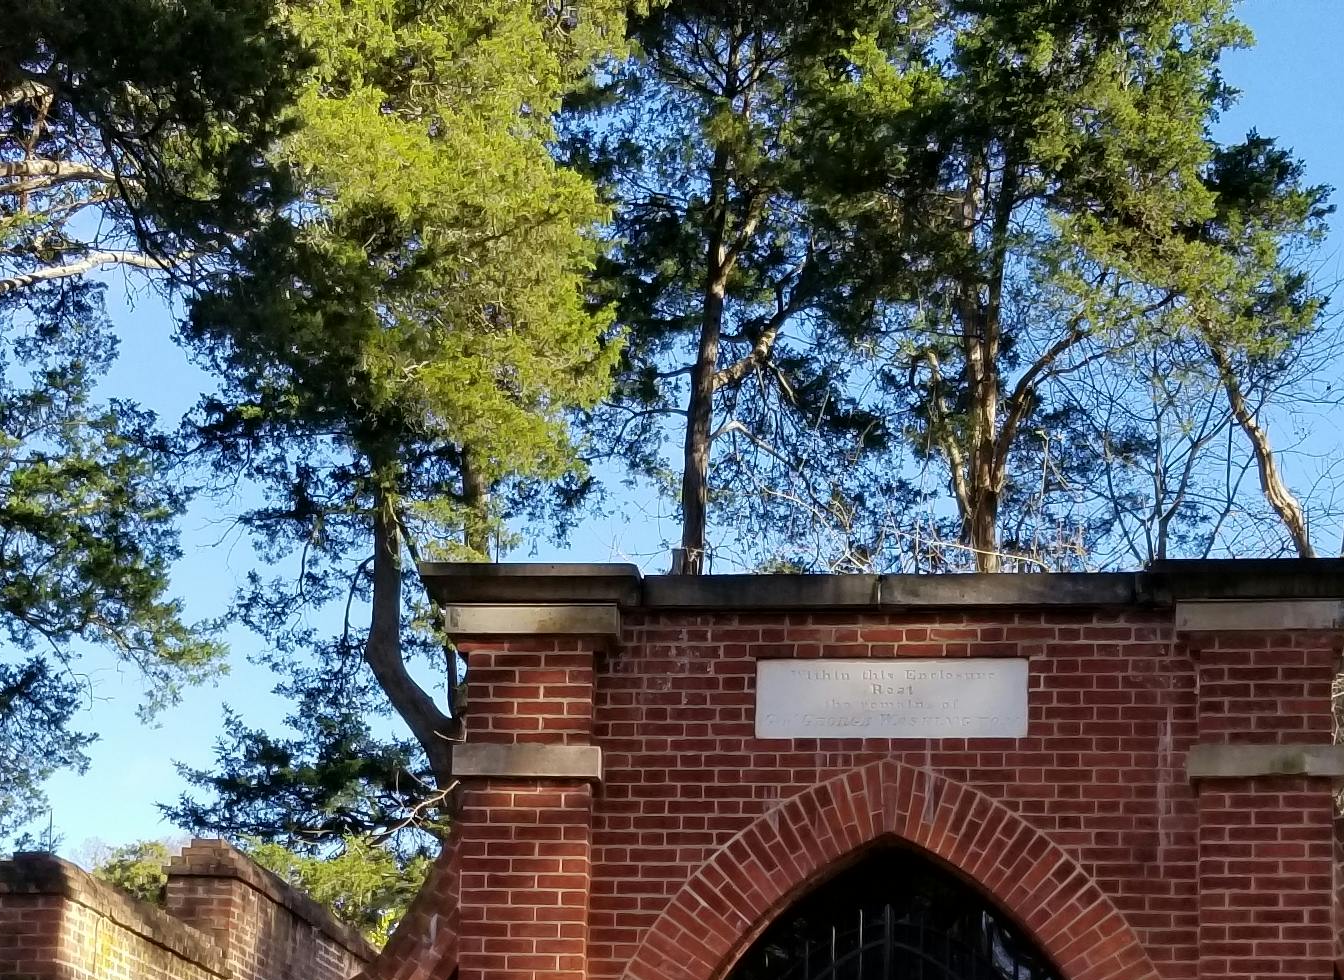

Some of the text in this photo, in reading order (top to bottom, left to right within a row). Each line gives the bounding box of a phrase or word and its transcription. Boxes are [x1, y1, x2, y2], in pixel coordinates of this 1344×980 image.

[862, 669, 895, 681] this
[905, 669, 995, 681] Enclosure
[872, 683, 913, 696] Rest
